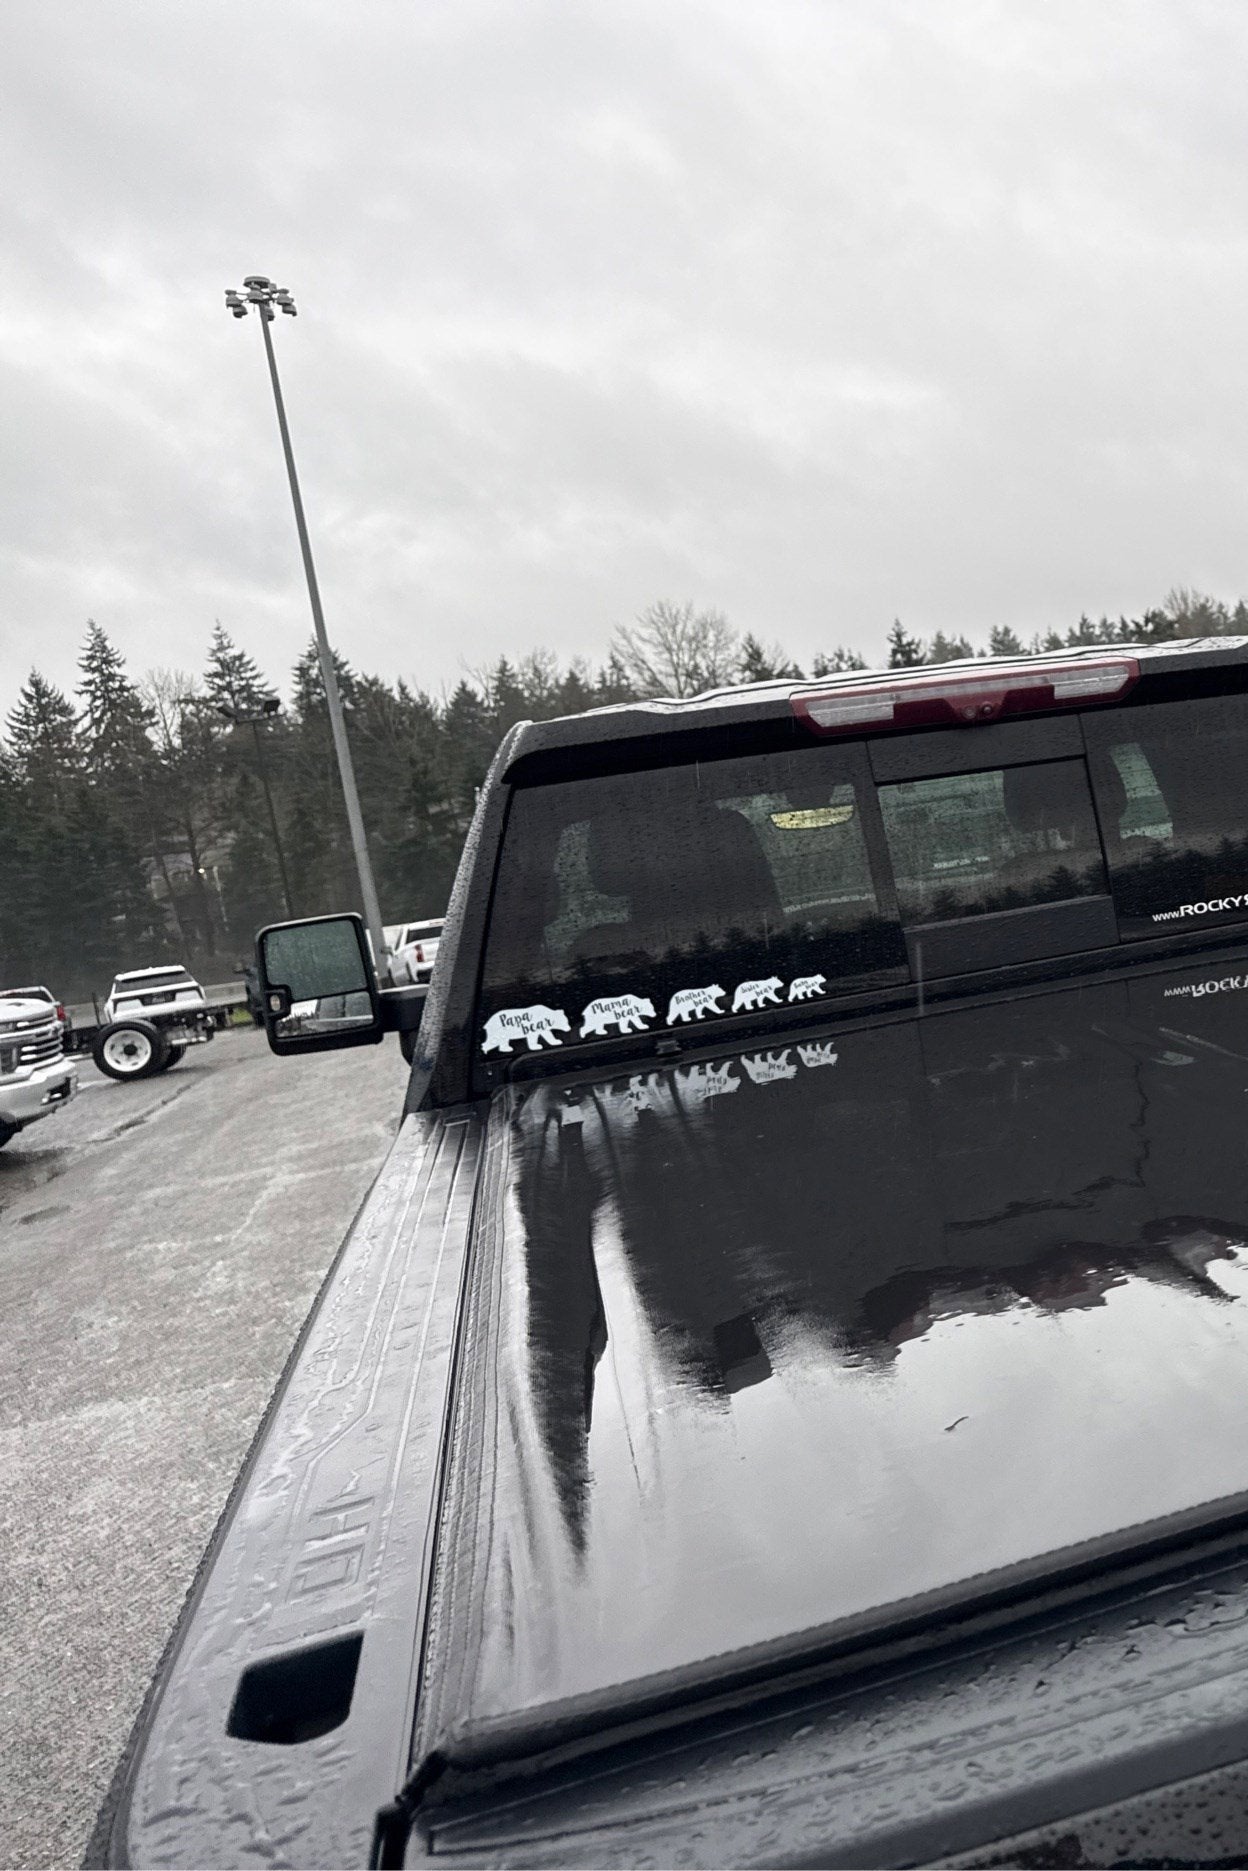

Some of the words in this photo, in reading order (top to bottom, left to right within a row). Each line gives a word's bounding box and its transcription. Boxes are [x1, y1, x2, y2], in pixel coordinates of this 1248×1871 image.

[675, 990, 706, 1005] Brother
[756, 985, 773, 996] bear
[591, 998, 630, 1015] Mama
[693, 995, 713, 1008] bear
[499, 1012, 533, 1028] Papa
[614, 1005, 641, 1020] bear
[521, 1018, 554, 1036] bear
